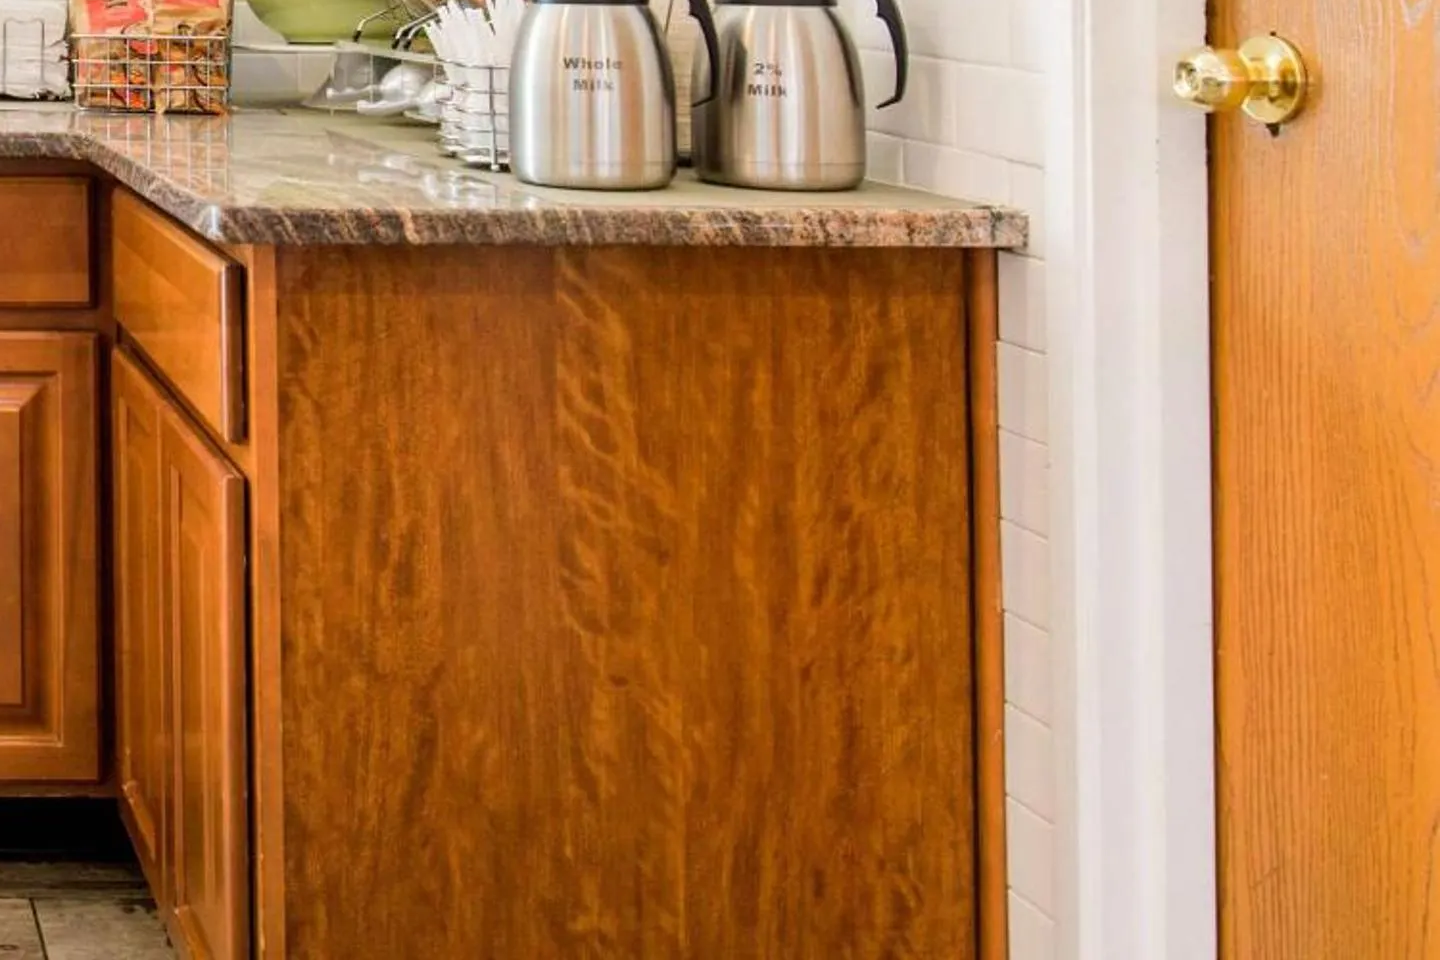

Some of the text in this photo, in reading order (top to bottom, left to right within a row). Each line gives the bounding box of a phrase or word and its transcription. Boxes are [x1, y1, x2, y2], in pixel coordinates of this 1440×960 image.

[563, 57, 623, 70] Whole
[753, 62, 783, 77] 2%
[573, 79, 615, 91] Milk
[747, 84, 788, 97] Milk
